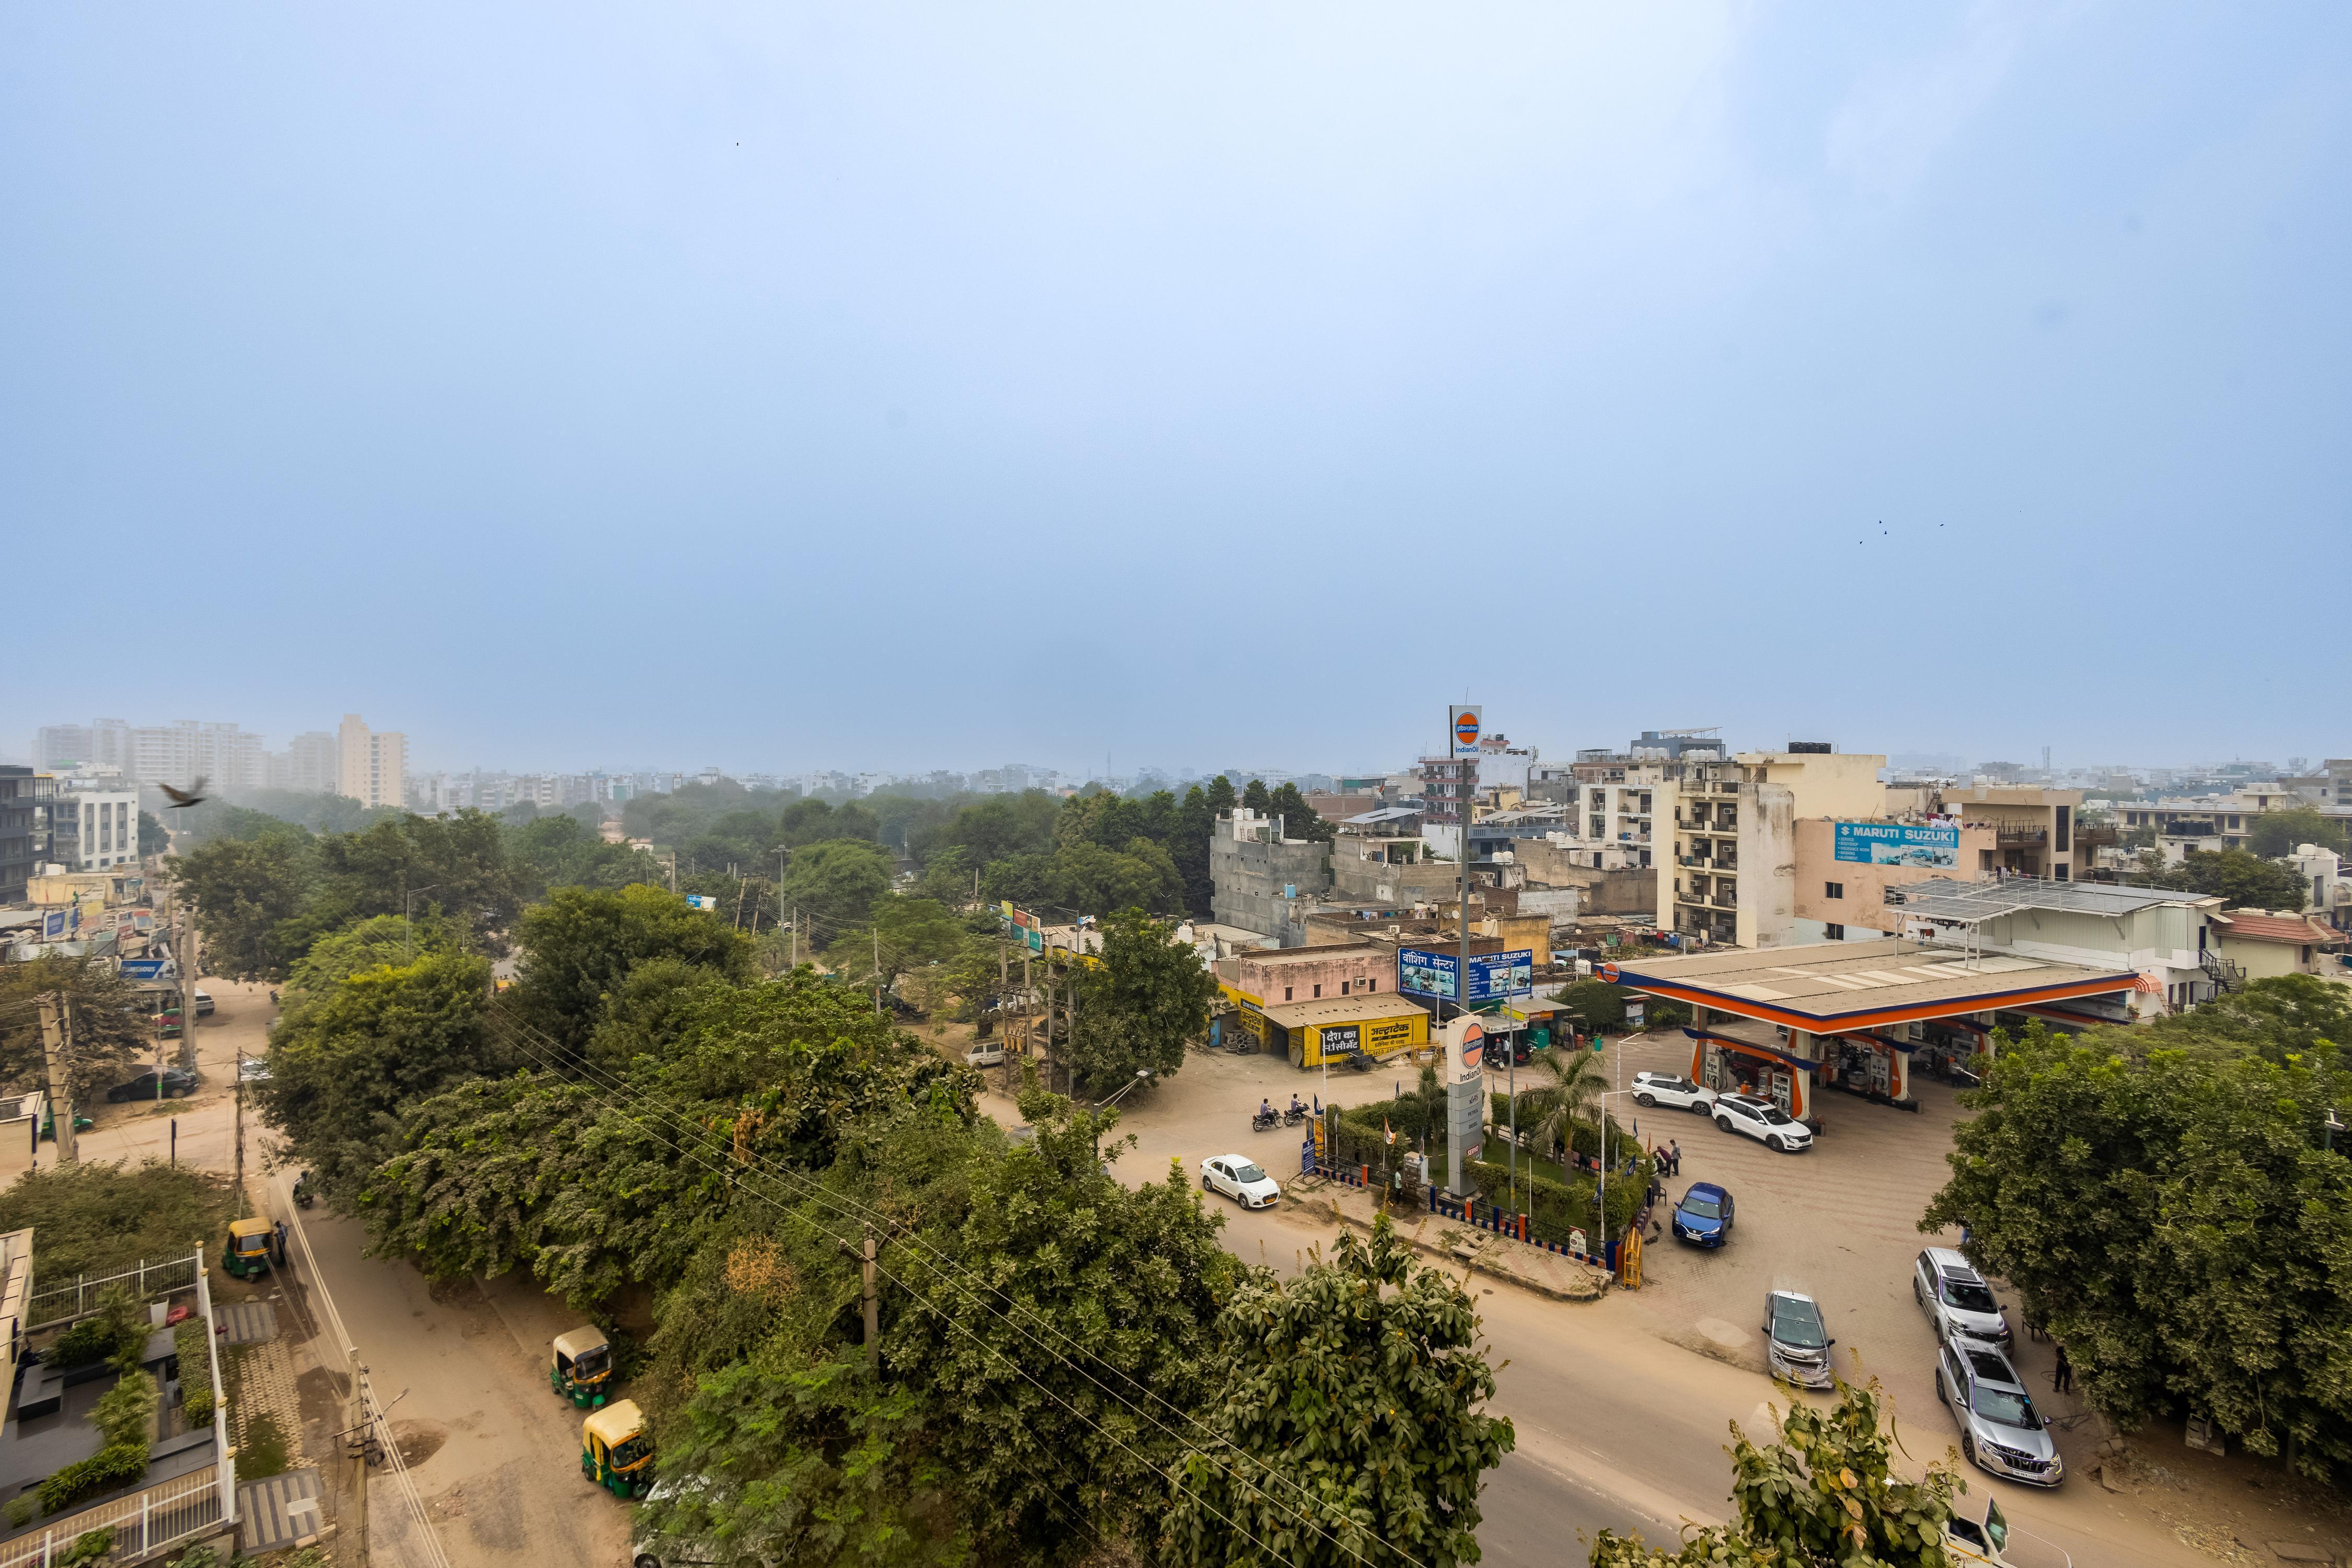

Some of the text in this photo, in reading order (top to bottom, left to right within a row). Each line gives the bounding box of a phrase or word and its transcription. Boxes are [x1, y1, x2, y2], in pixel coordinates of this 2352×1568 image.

[1853, 827, 1954, 841] MARUTI SUZUKI
[1402, 951, 1455, 971] वॉशिंग सेन्टर
[1502, 951, 1531, 960] SUZUKI
[1370, 1023, 1410, 1035] अल्ट्राटेक
[1327, 1030, 1357, 1042] देश का
[1336, 1039, 1358, 1051] सीमेंट
[1468, 1109, 1479, 1117] PETROL
[1467, 1145, 1479, 1156] SERVO
